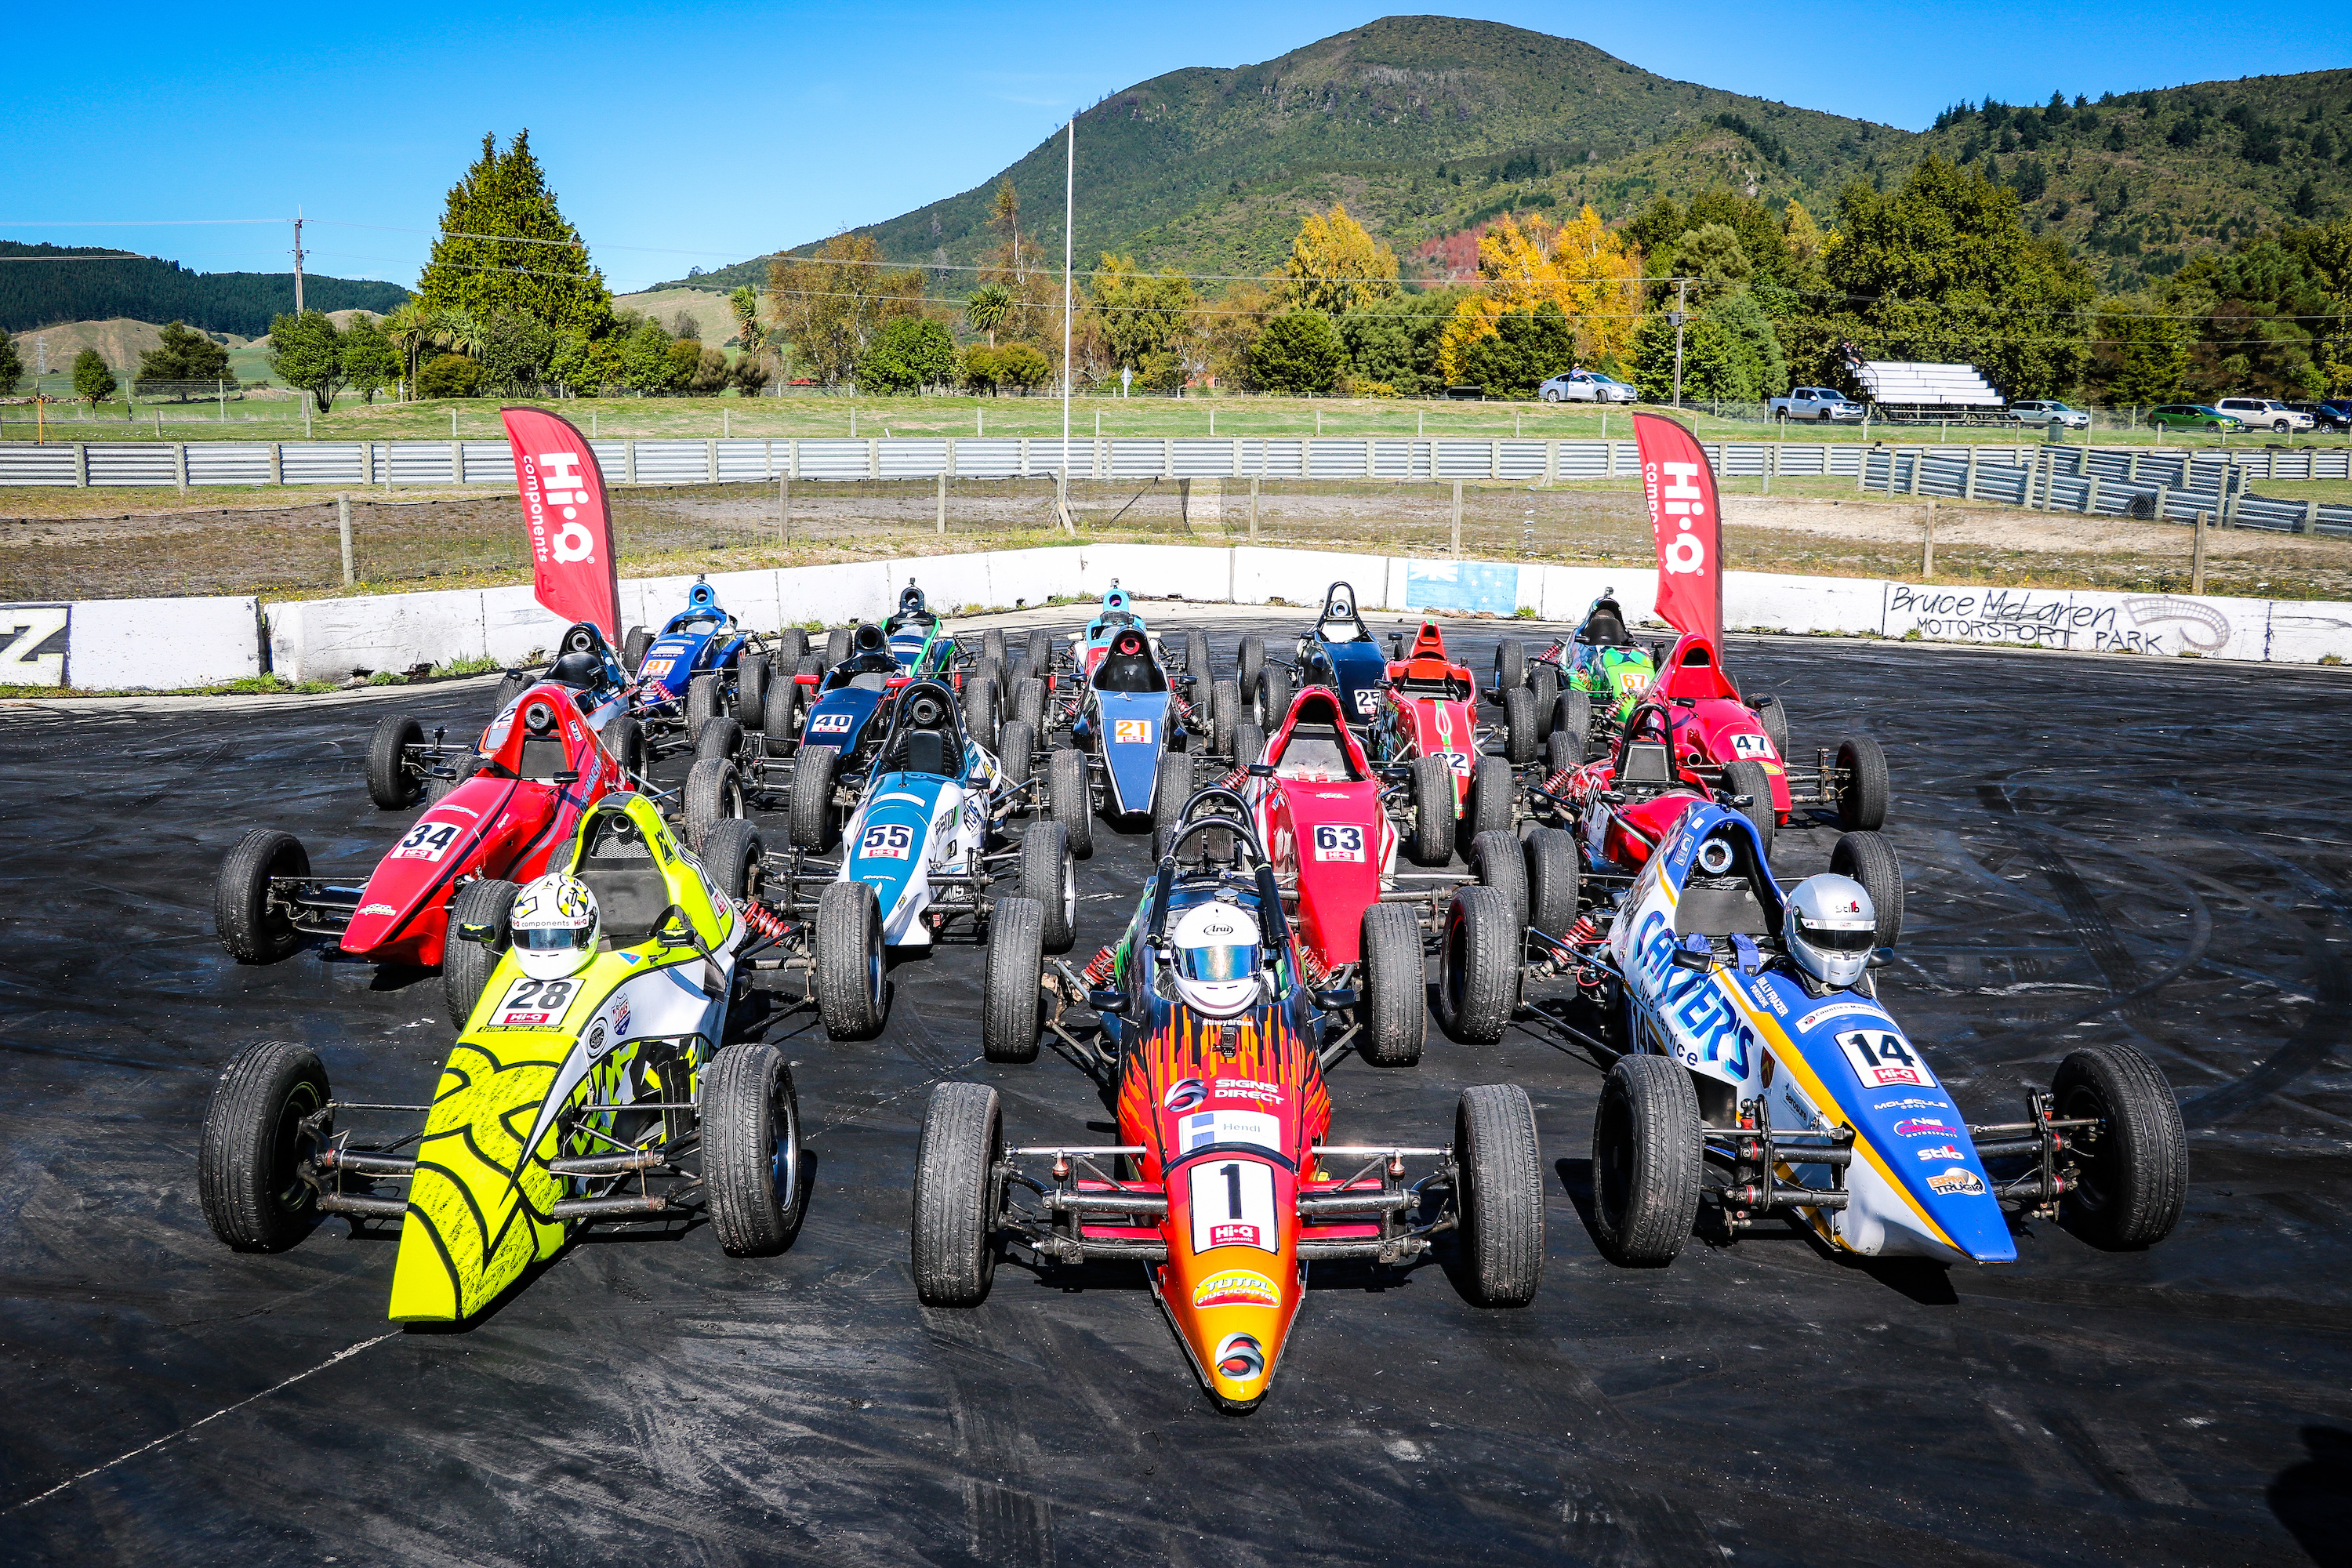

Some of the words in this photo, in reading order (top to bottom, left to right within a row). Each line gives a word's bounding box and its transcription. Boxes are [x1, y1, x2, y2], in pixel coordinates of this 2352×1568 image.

[523, 455, 548, 563] components
[1890, 586, 1976, 616] Bruce
[1982, 590, 2117, 627] McLaren
[1916, 616, 2078, 649] MOTORSPORT
[2095, 630, 2165, 655] PARK
[647, 660, 671, 670] 91
[1622, 674, 1646, 688] 67
[816, 716, 851, 727] 40
[1117, 721, 1145, 735] 21
[1737, 736, 1766, 750] 47
[402, 824, 458, 851] 34
[864, 826, 909, 848] 55
[1316, 827, 1361, 851] 63
[1835, 900, 1860, 913] Stilo
[1210, 924, 1230, 934] Arai
[506, 982, 572, 1009] 28
[1755, 976, 1773, 996] BILLY
[1766, 991, 1790, 1018] FRAZER
[1815, 1004, 1849, 1018] Counties
[1202, 1018, 1254, 1028] #theyareus
[1639, 978, 1655, 1013] tyre
[1656, 1011, 1699, 1066] service
[1847, 1033, 1915, 1067] 14
[1214, 1079, 1279, 1094] SIGNS
[1214, 1089, 1285, 1105] DIRECT
[1873, 1098, 1949, 1110] MOLECULE
[1785, 1092, 1807, 1122] aerosure
[1911, 1117, 1944, 1127] Neil
[1917, 1145, 1965, 1161] Stilo
[1927, 1174, 1968, 1187] BPM
[1220, 1163, 1243, 1220] 1
[1933, 1184, 1982, 1194] TRUCK
[1205, 1276, 1272, 1294] TOTAL
